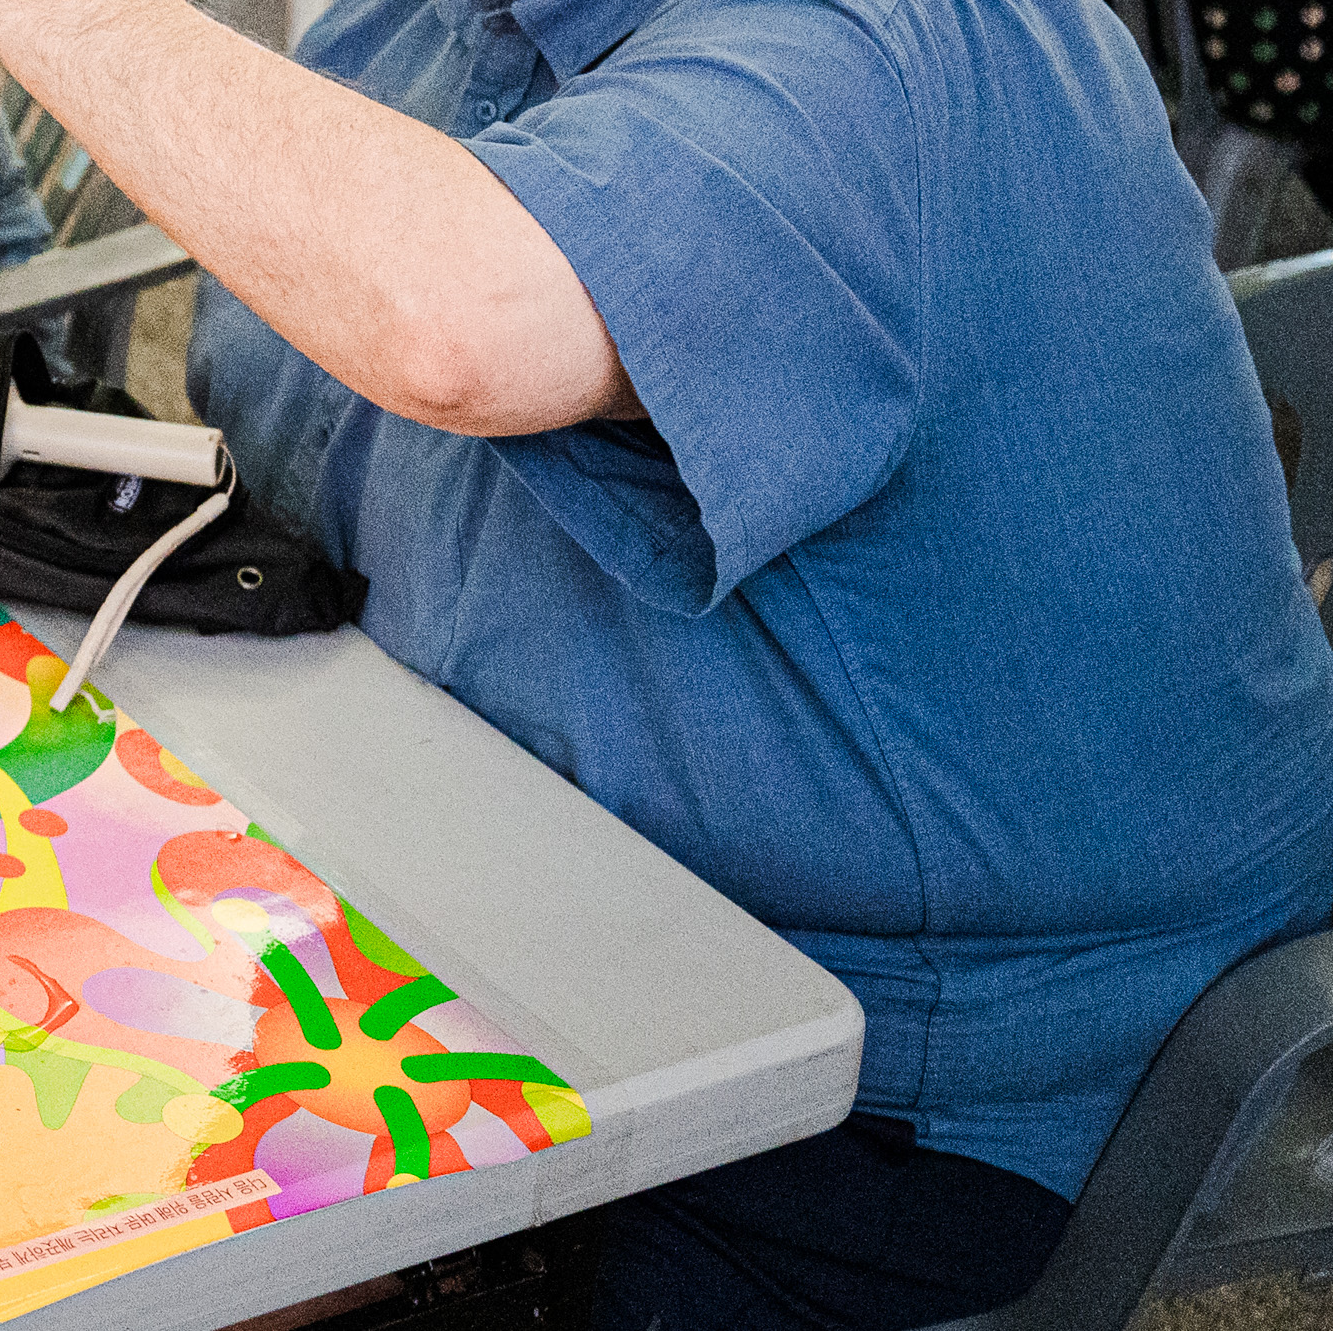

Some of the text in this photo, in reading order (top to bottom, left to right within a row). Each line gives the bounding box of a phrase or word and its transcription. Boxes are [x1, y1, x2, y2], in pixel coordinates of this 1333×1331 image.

[233, 1176, 267, 1195] 다음
[188, 1187, 234, 1210] 사람을
[155, 1200, 189, 1221] 위해
[123, 1213, 156, 1231] 머문
[74, 1223, 124, 1244] 자리는
[11, 1233, 77, 1266] 깨끗하게
